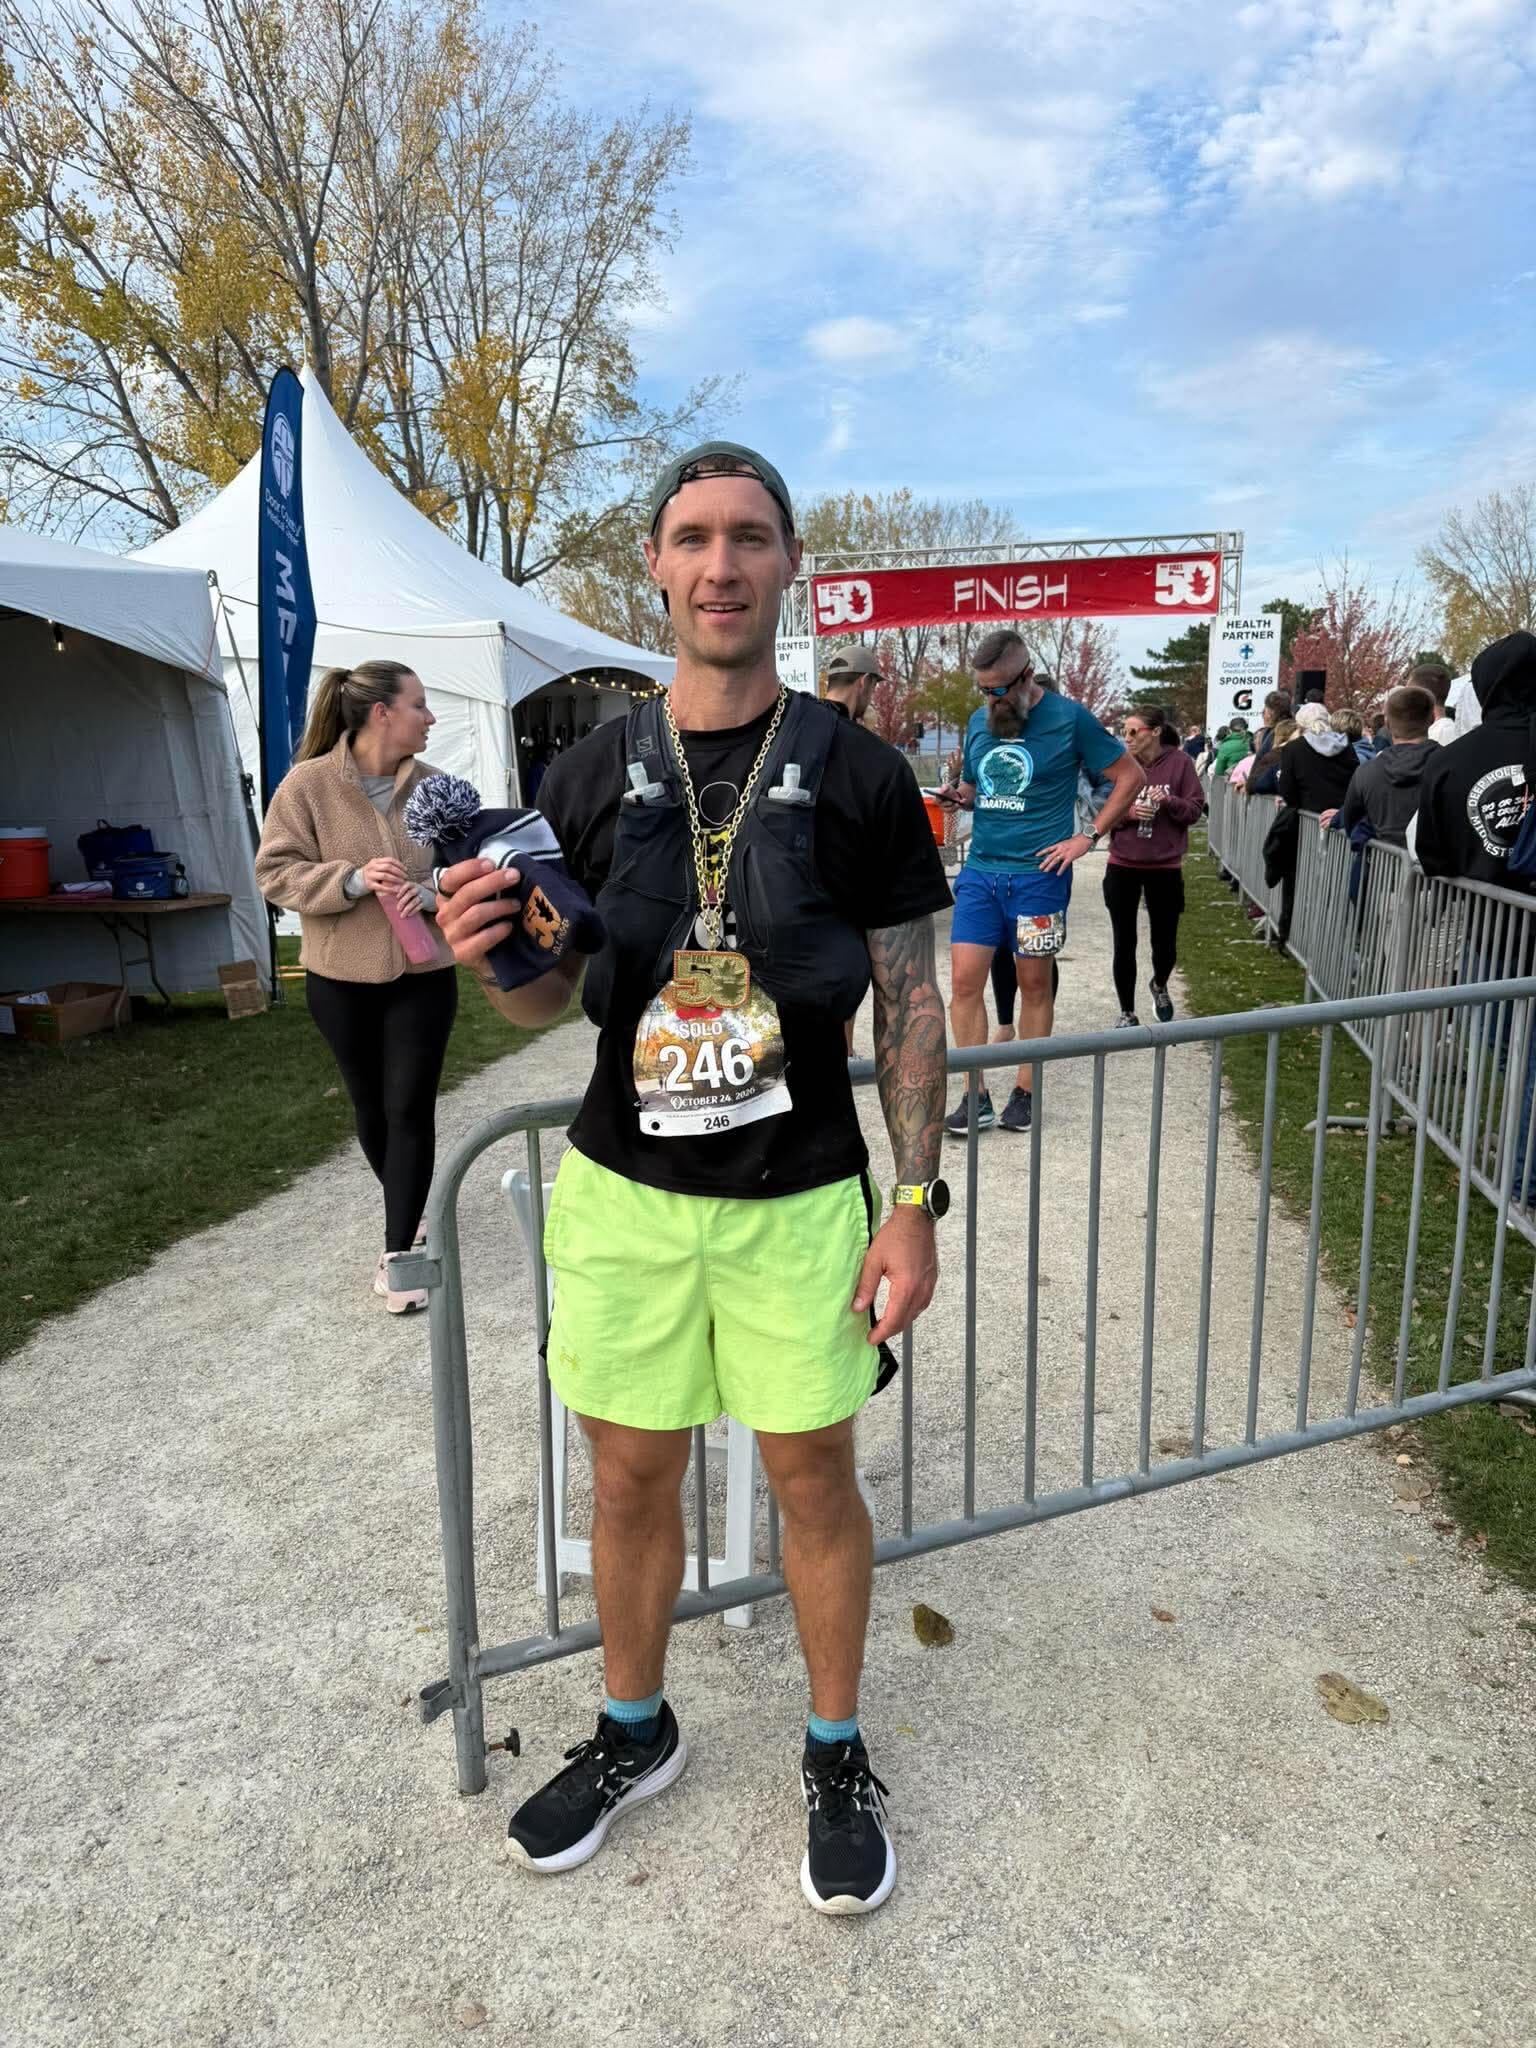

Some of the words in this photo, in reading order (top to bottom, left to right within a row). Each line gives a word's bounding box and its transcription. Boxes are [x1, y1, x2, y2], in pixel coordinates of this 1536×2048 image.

[1154, 560, 1216, 605] 50
[954, 573, 1068, 613] FINISH
[816, 580, 873, 626] 50
[1226, 619, 1272, 630] HEALTH
[1222, 631, 1275, 641] PARTNER
[776, 641, 810, 651] SENTED
[779, 653, 791, 662] BY
[1222, 660, 1241, 669] Door
[1242, 660, 1270, 669] County
[1219, 676, 1273, 686] SPONSORS
[679, 1021, 722, 1039] SOLO
[658, 1038, 754, 1092] 246
[670, 1095, 718, 1110] OCTOBER
[703, 1115, 730, 1131] 246
